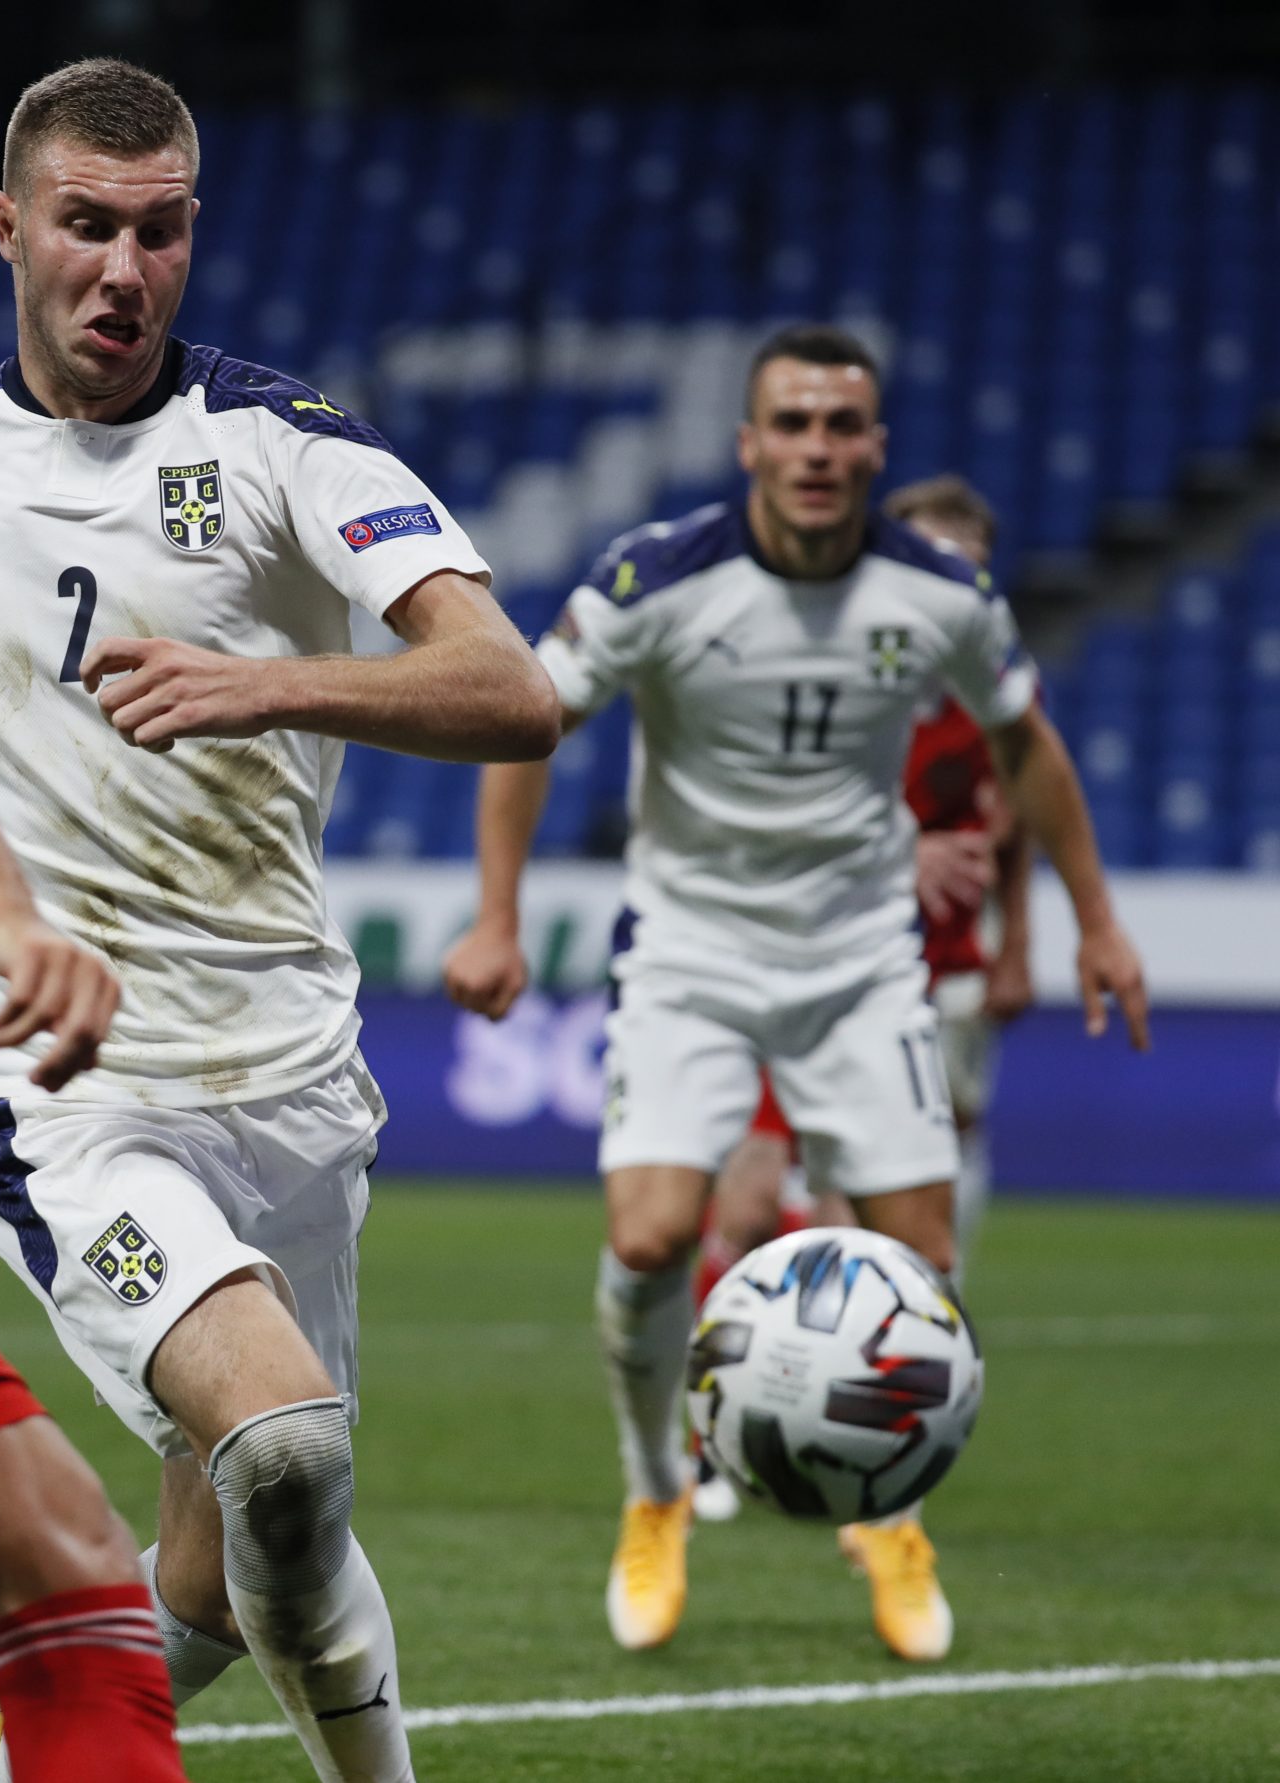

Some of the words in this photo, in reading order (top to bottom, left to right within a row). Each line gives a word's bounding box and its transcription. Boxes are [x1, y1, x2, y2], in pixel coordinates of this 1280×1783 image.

[161, 463, 217, 478] СРБИЈА
[371, 512, 432, 533] RESPECT
[57, 566, 103, 683] 2
[782, 682, 841, 754] 17
[85, 1217, 129, 1262] СРБИЈА
